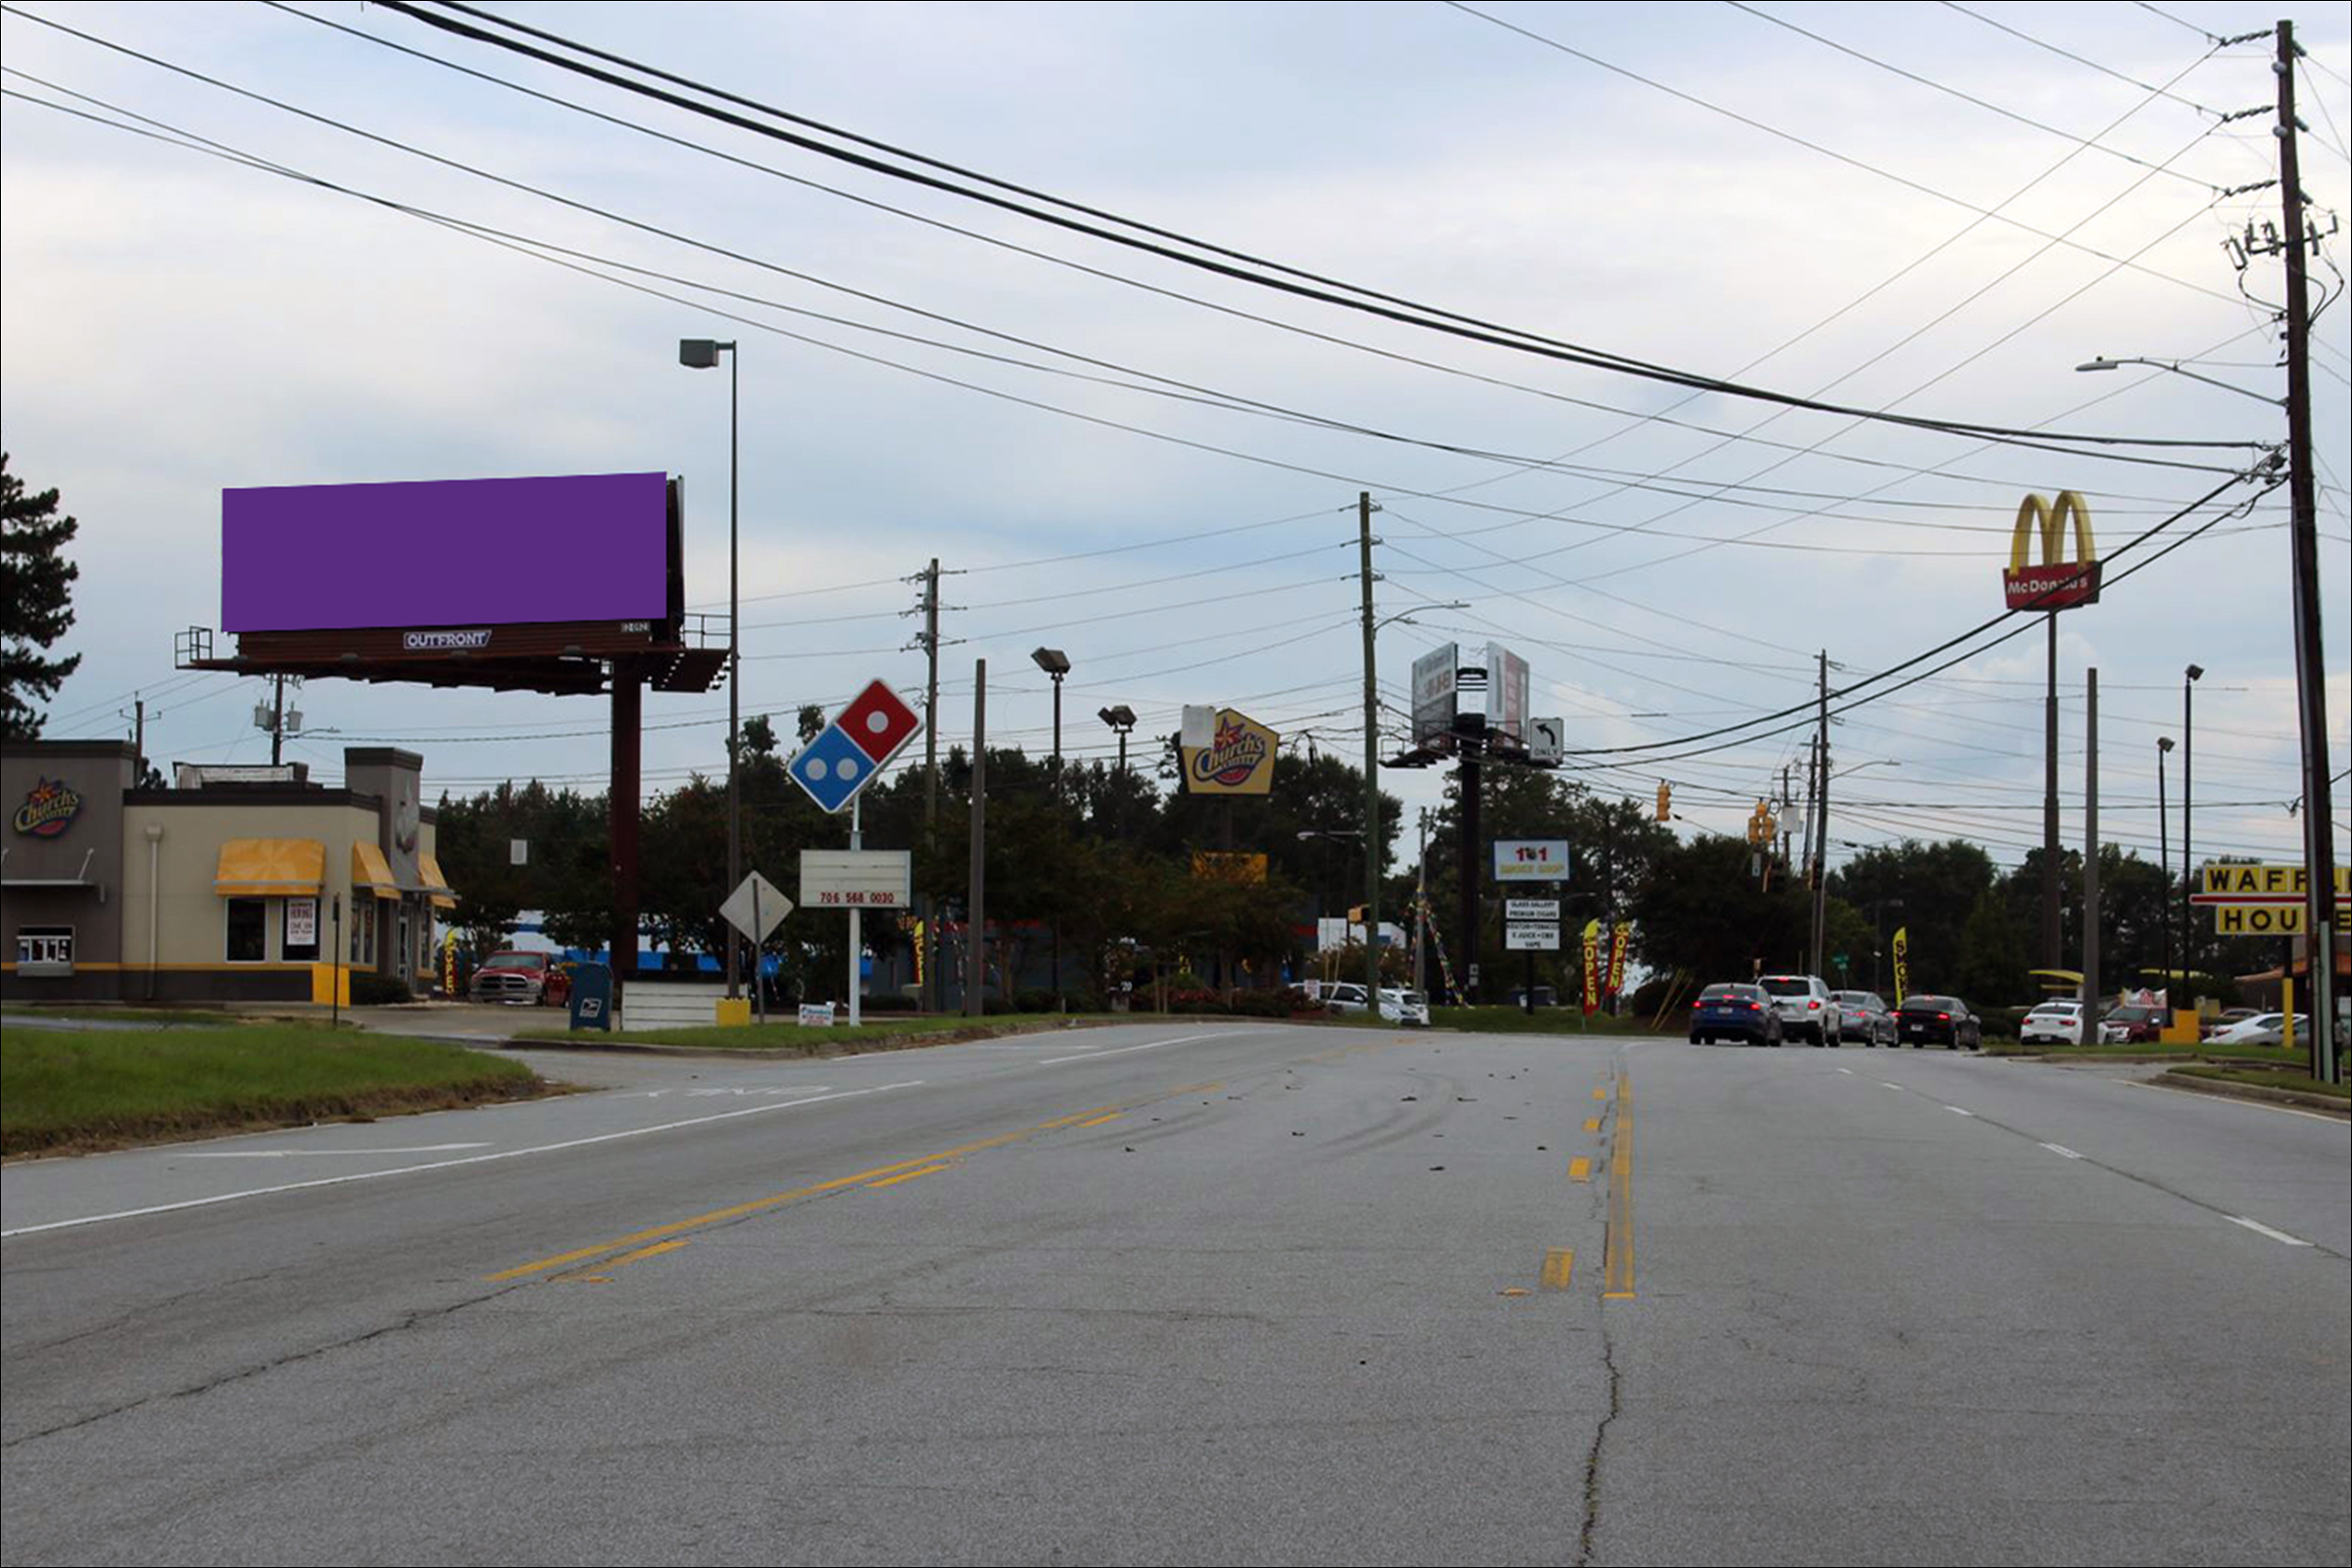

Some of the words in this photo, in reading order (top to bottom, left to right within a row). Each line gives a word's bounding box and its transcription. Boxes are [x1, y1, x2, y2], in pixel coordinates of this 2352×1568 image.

[408, 632, 486, 647] OUTFRONT
[1534, 748, 1558, 758] ONLY
[2209, 869, 2351, 891] WAFF
[820, 891, 840, 904] 706
[846, 891, 864, 904] 568
[2224, 908, 2351, 931] HOUE
[1608, 936, 1627, 988] OPEN
[1584, 946, 1597, 1006] OPEN
